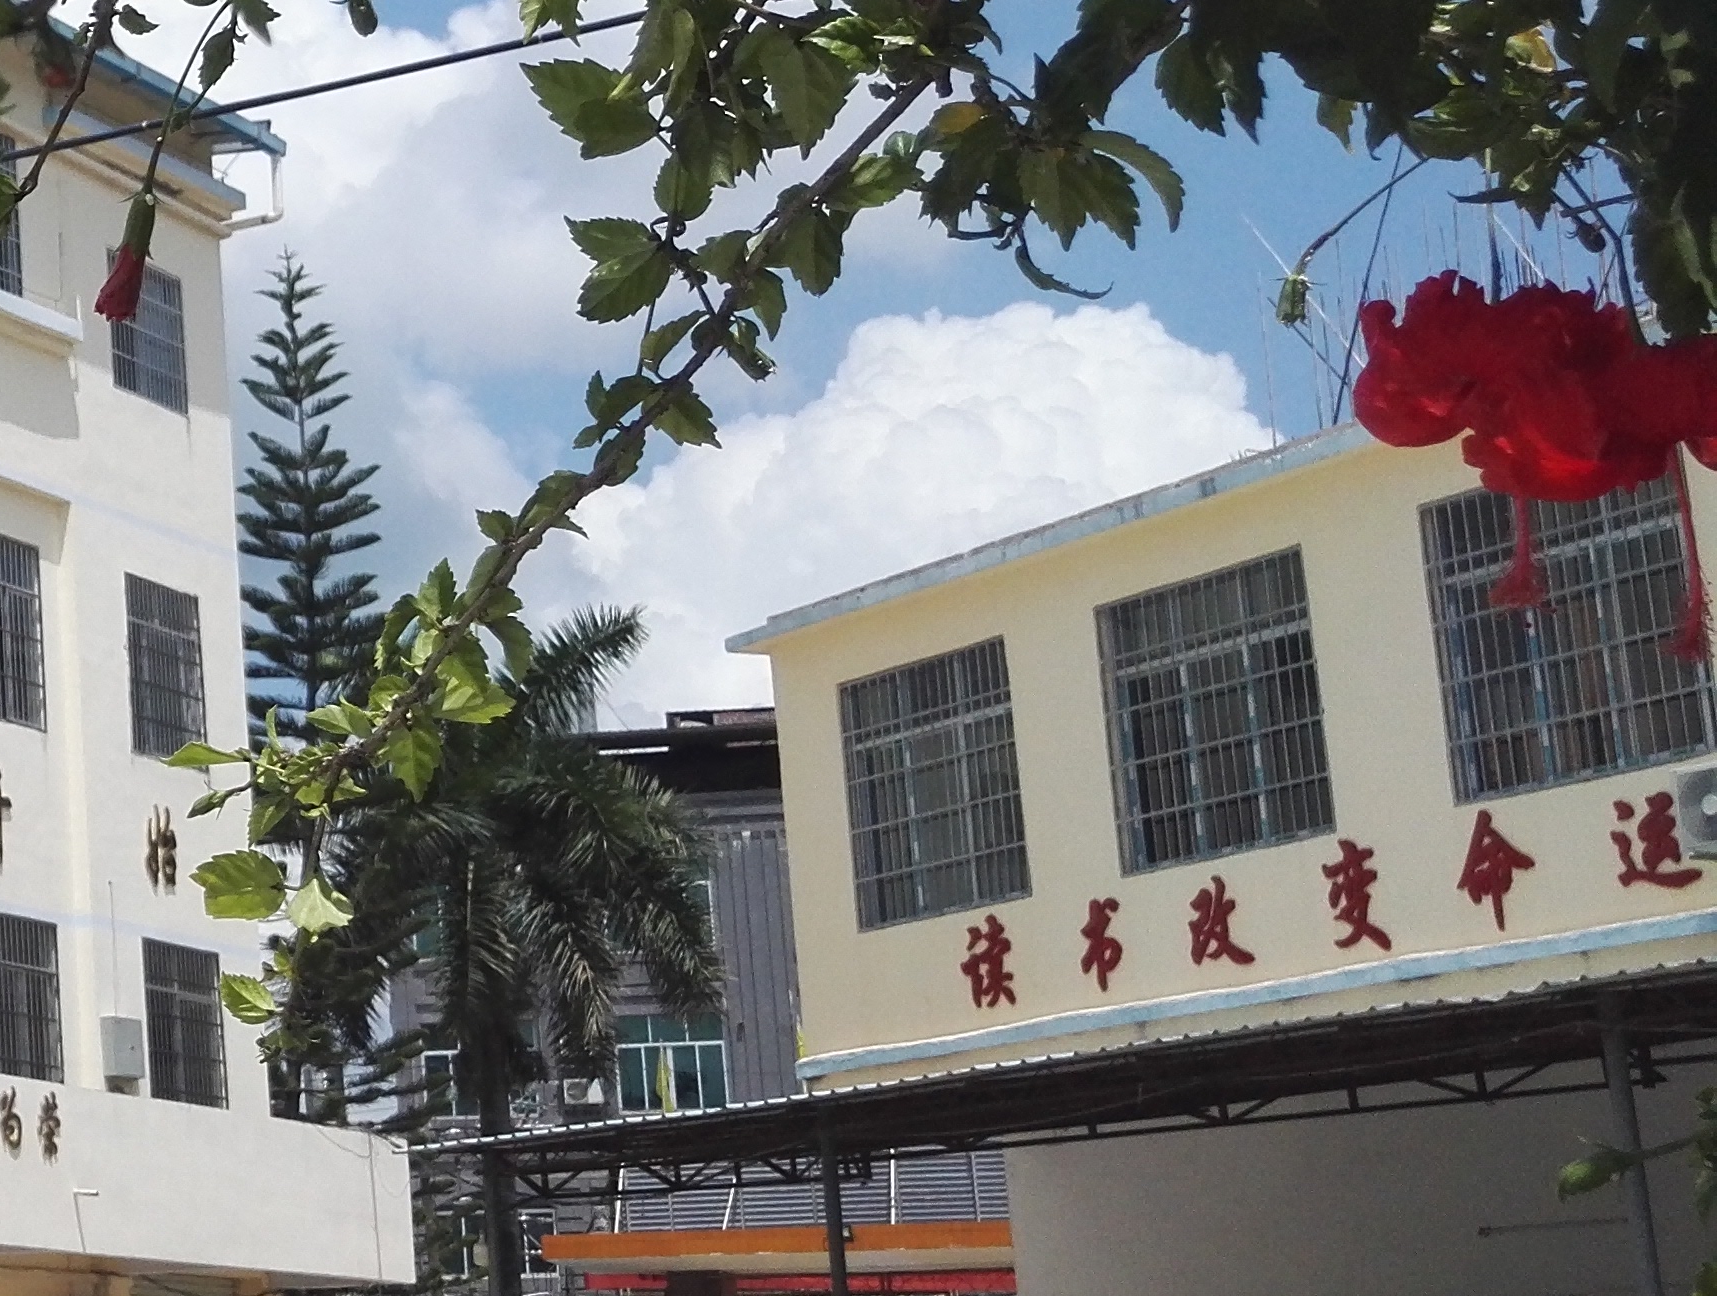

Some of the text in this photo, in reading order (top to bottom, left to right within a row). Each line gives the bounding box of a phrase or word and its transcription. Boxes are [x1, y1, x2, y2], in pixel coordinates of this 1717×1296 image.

[961, 792, 1703, 1009] 读书改变命运
